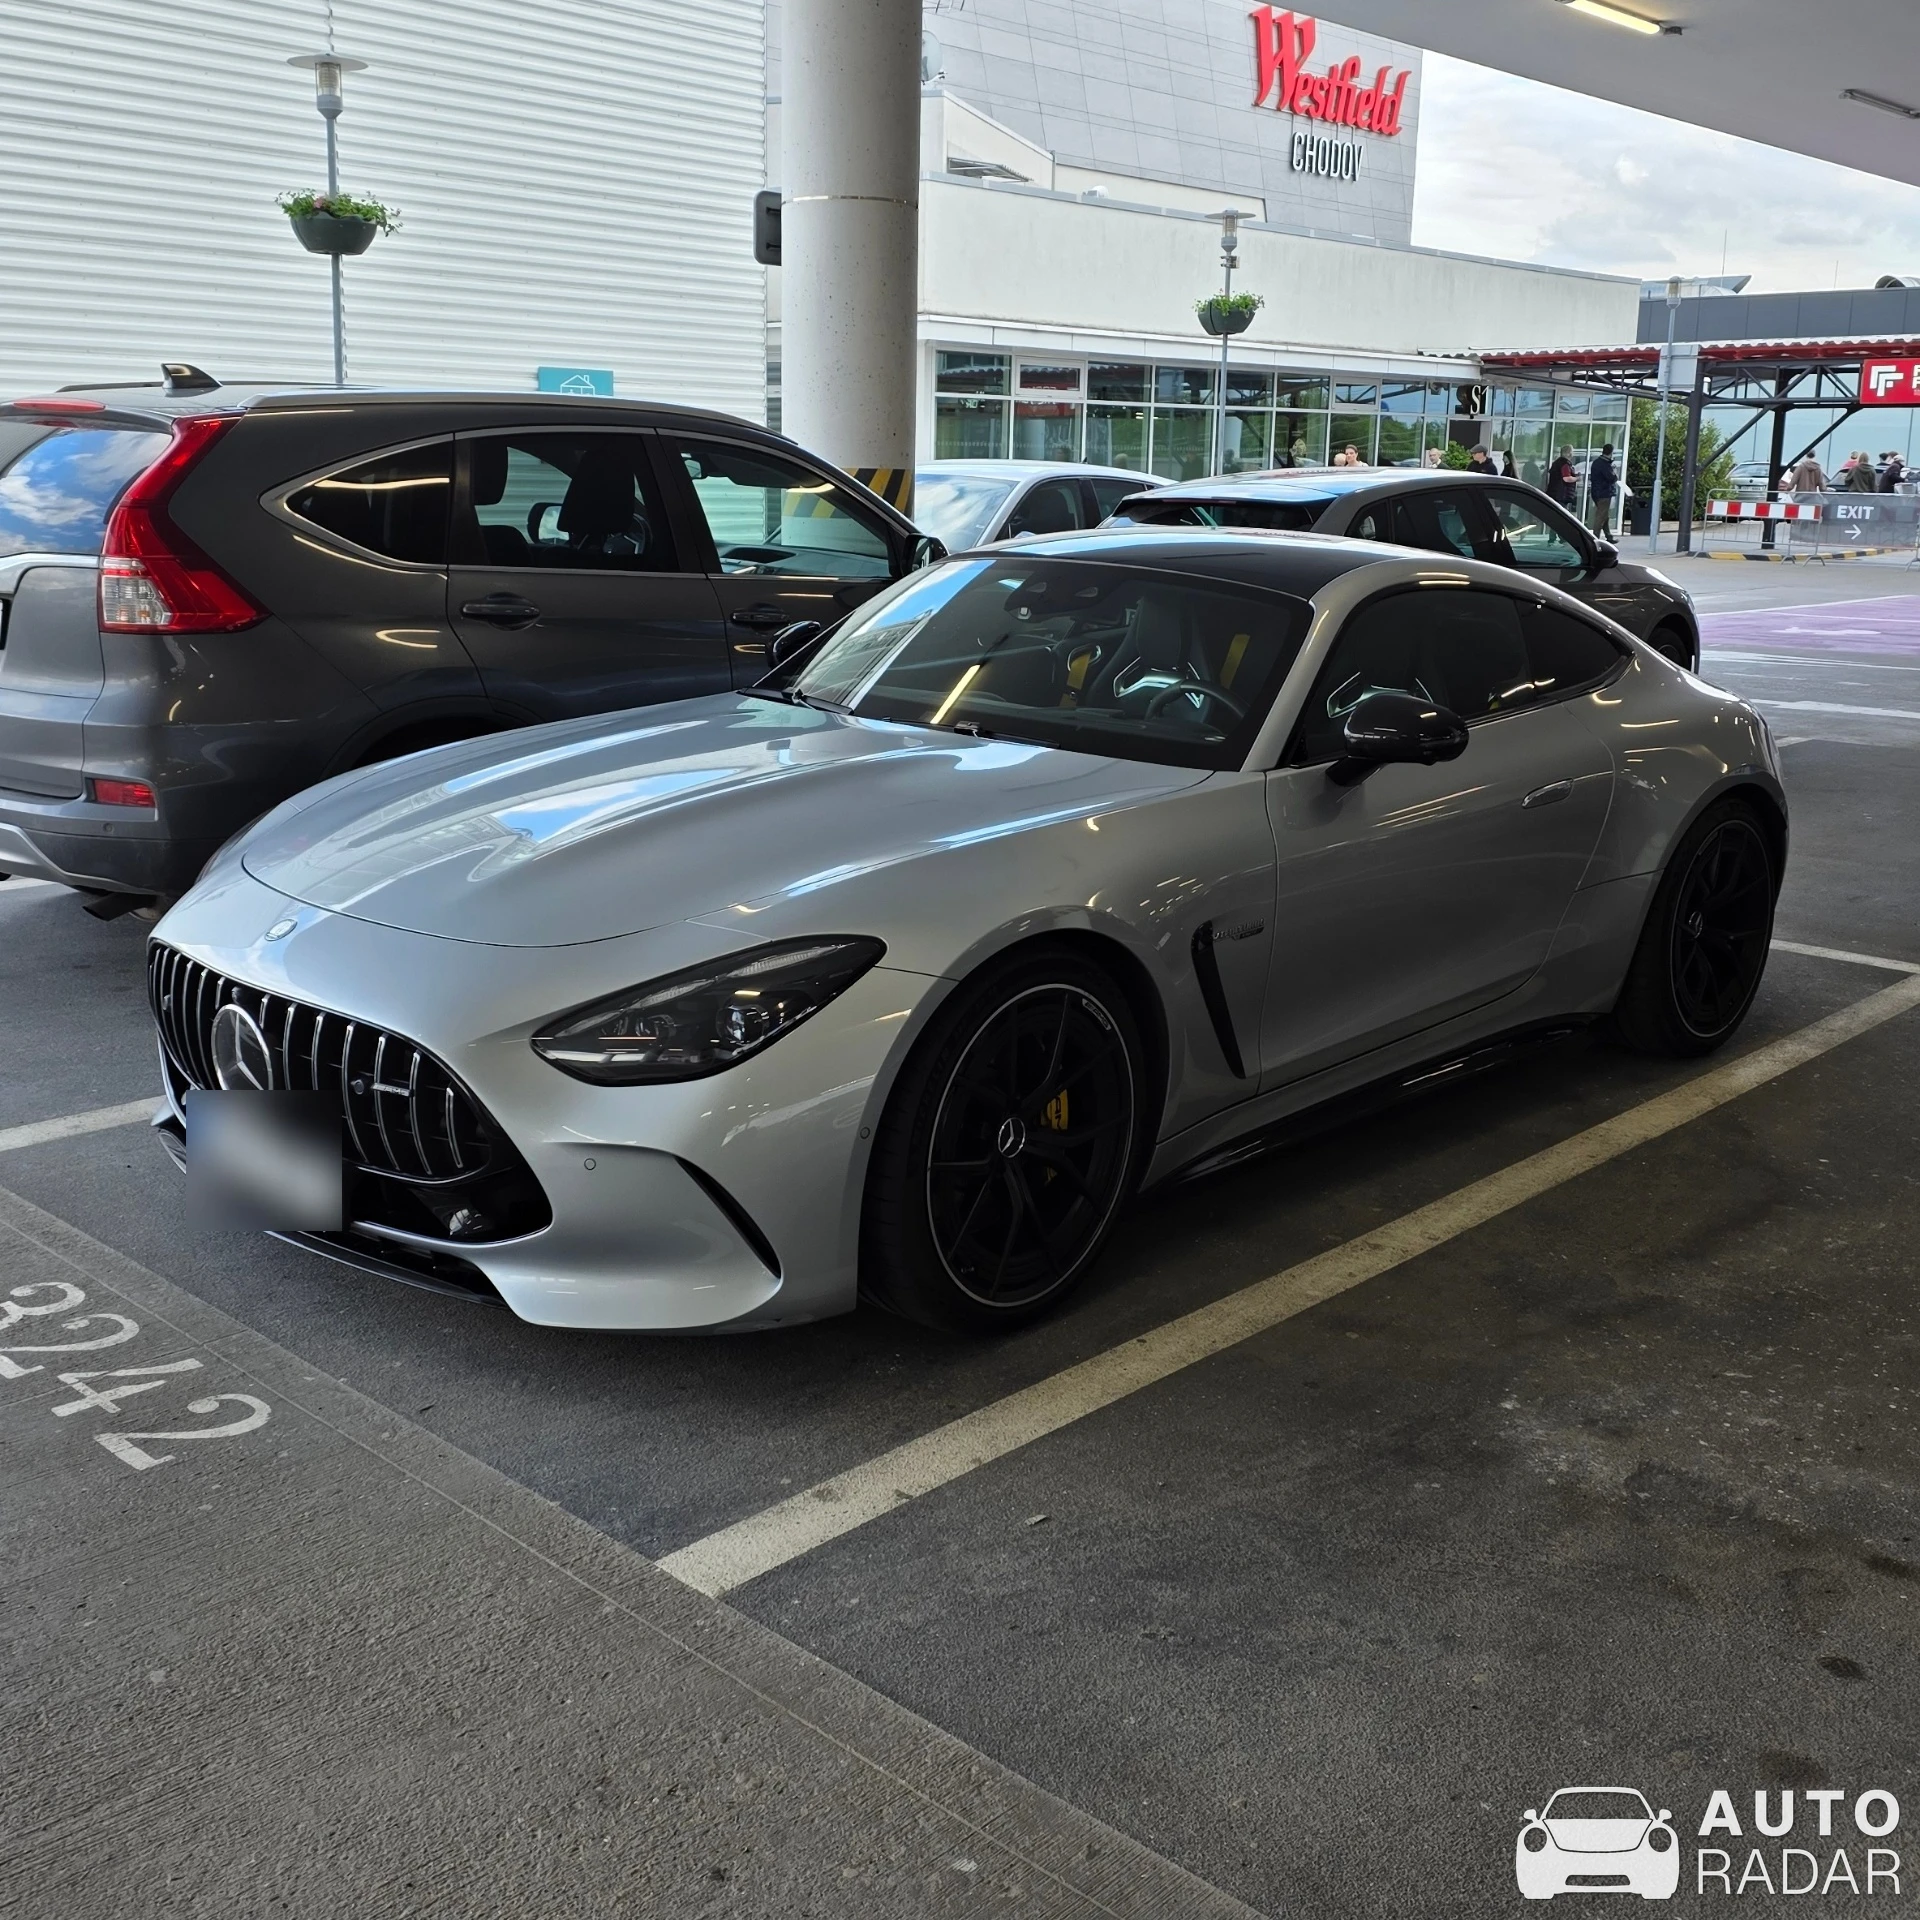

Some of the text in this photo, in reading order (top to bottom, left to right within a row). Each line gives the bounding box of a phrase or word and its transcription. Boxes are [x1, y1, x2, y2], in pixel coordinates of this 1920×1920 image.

[1249, 5, 1412, 136] Westfield
[1291, 131, 1364, 182] CHODOV
[1836, 504, 1875, 520] EXIT
